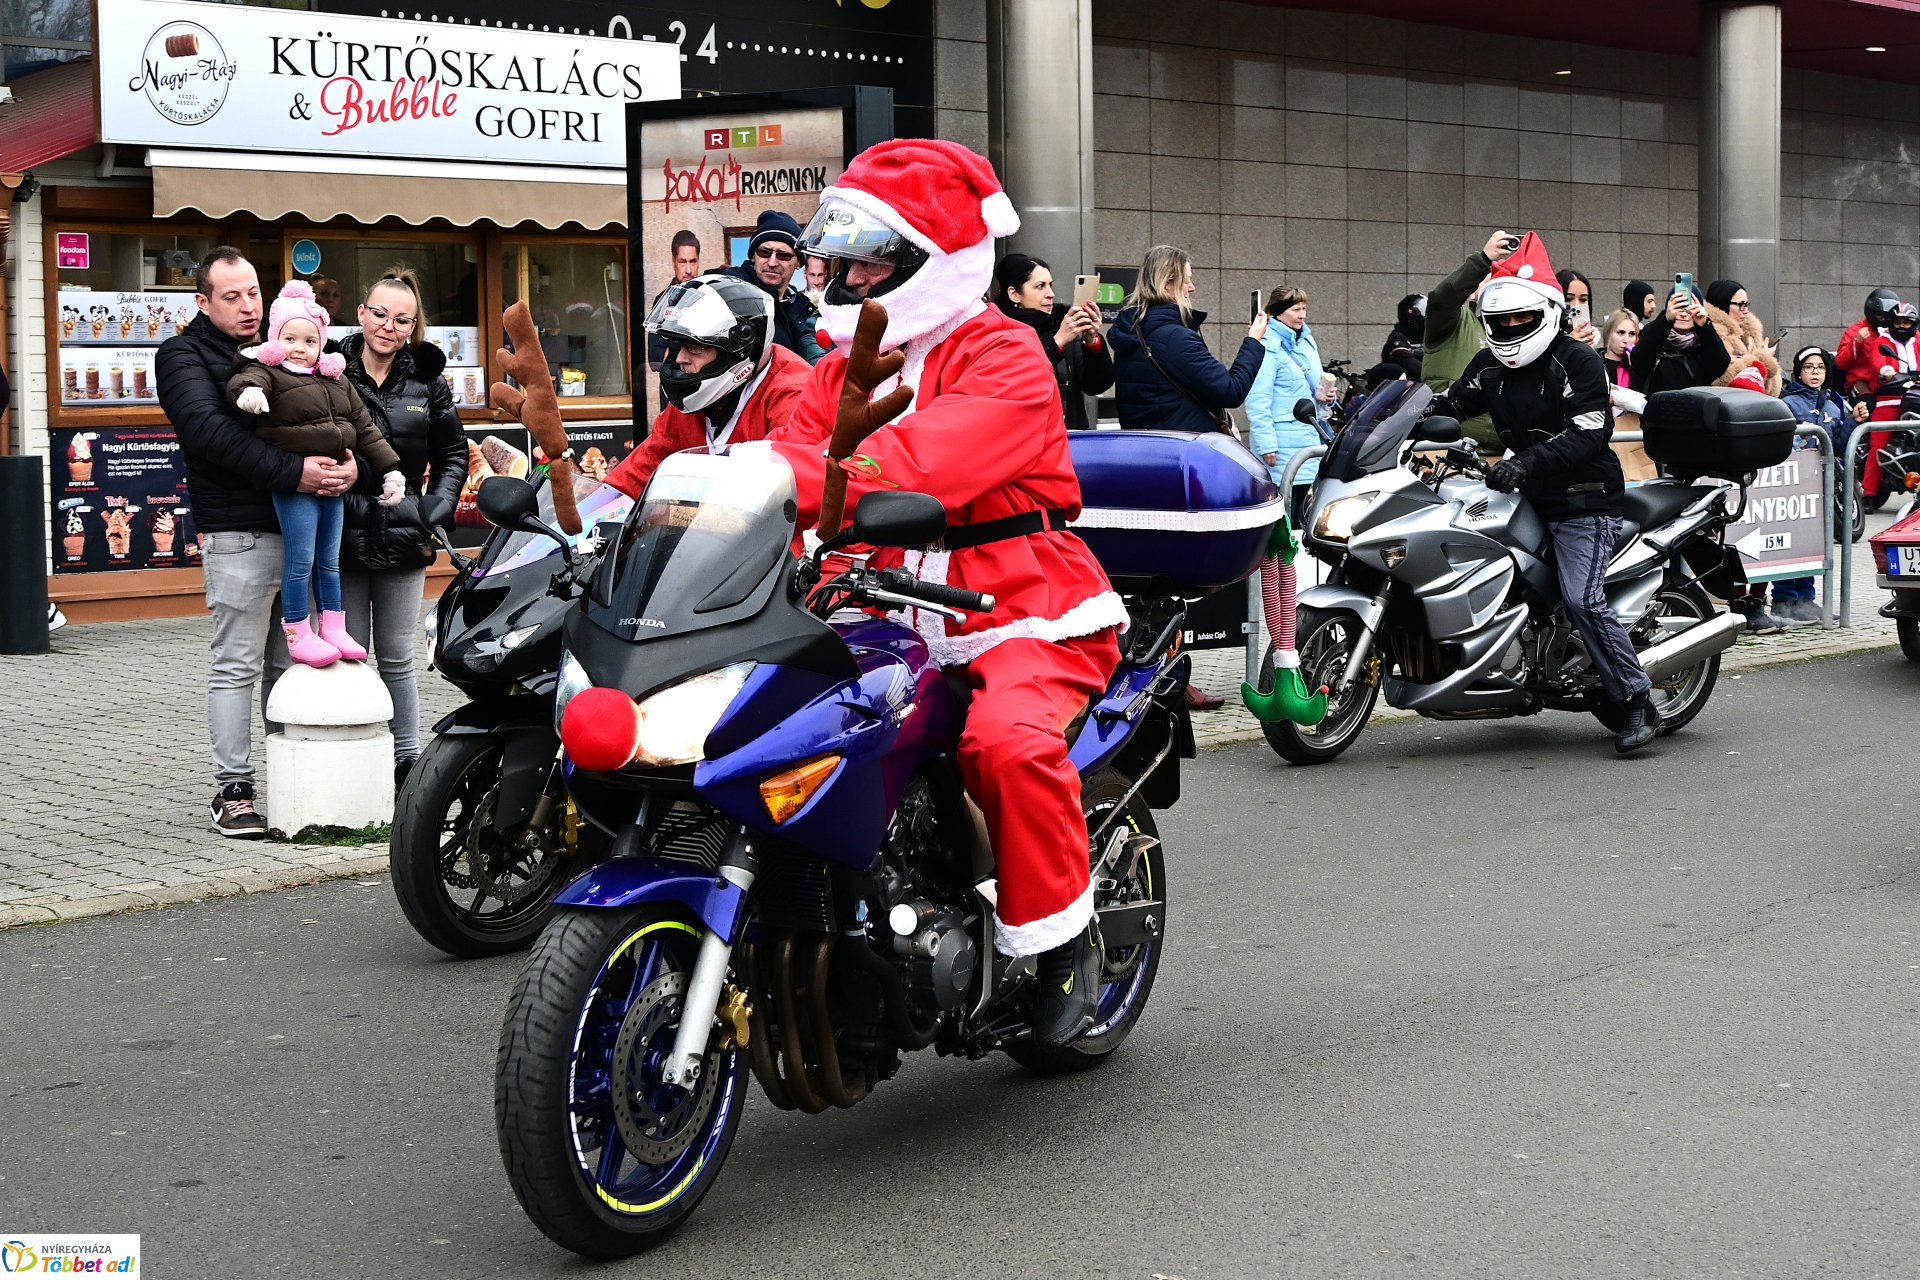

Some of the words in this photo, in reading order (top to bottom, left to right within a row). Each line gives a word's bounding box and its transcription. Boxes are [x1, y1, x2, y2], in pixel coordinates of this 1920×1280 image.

[268, 30, 643, 99] KÜRTŐSKALÁCS
[129, 58, 236, 92] Nagyi-Házi
[289, 93, 312, 120] &
[320, 76, 458, 135] Bubble
[475, 105, 603, 142] GOFRI
[709, 128, 777, 147] RTL
[742, 166, 826, 195] ROKONOK
[60, 246, 86, 254] foodora
[296, 252, 316, 262] Wolt
[665, 309, 679, 317] BELL
[736, 366, 752, 380] BELL
[593, 432, 613, 440] FAGYI
[102, 443, 125, 453] Nagyi
[59, 497, 84, 509] OREO
[1469, 515, 1498, 523] HONDA
[1765, 536, 1774, 548] 15
[1775, 535, 1784, 548] M
[1908, 562, 1920, 574] 4
[618, 617, 666, 629] HONDA
[1114, 674, 1130, 700] CBF
